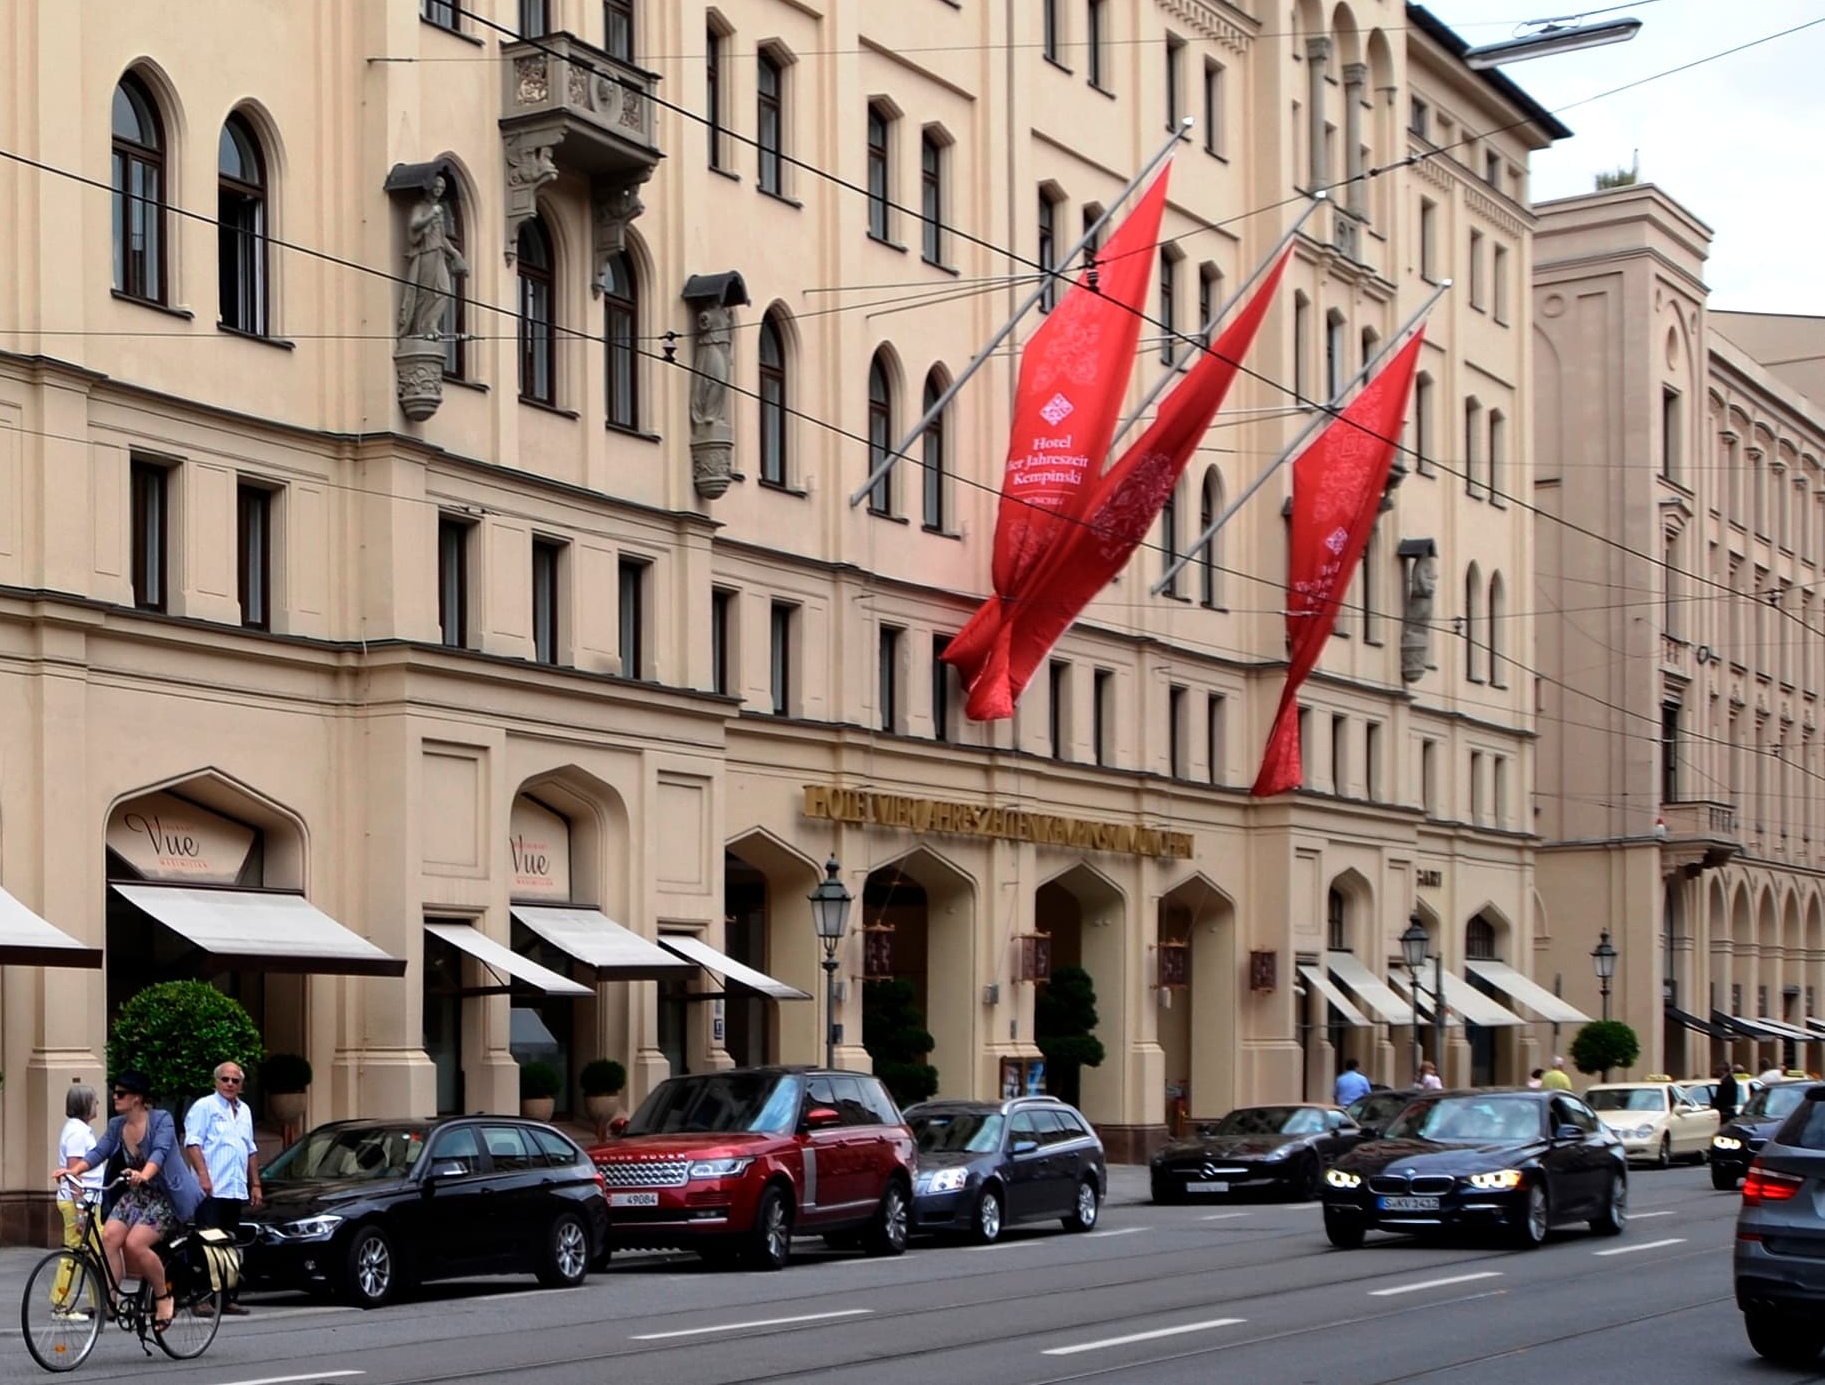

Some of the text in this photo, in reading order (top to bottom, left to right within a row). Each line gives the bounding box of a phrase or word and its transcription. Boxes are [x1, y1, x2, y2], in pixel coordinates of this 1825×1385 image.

[1033, 435, 1072, 450] Hotel
[1007, 459, 1024, 471] ier
[1013, 470, 1082, 486] Kempinski
[802, 785, 874, 823] HOTEL
[873, 793, 913, 829] VIER
[124, 813, 200, 857] Vue
[509, 834, 551, 876] Vue
[627, 1195, 656, 1204] 49084
